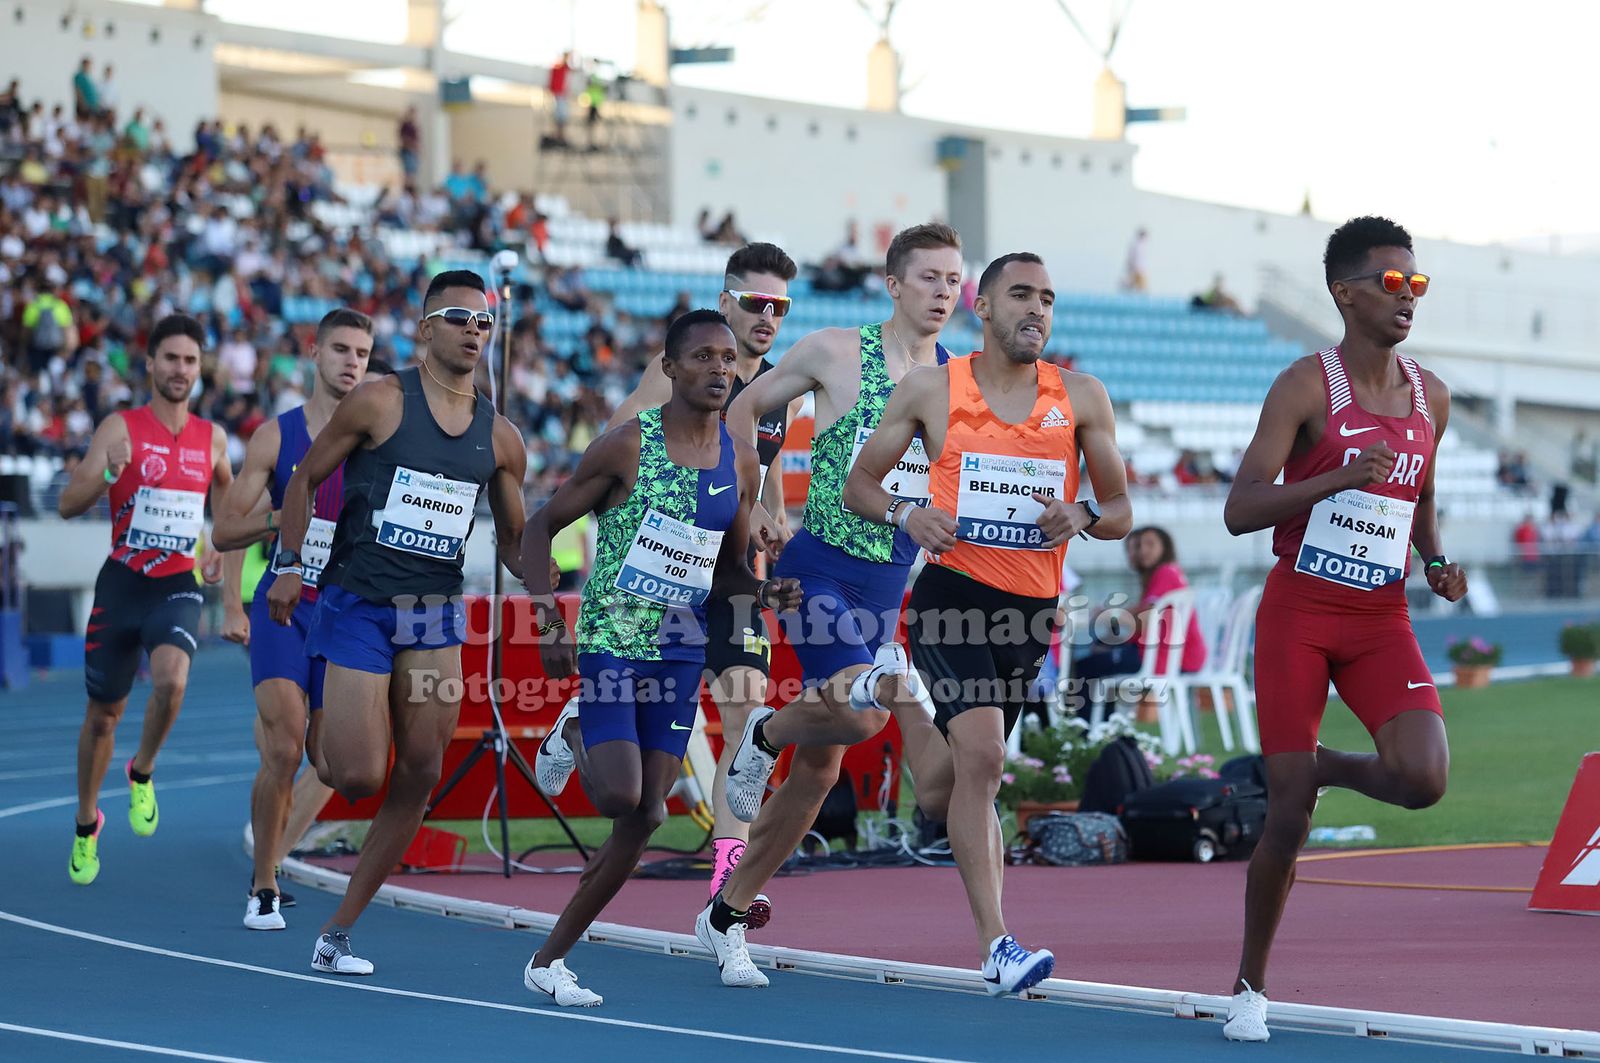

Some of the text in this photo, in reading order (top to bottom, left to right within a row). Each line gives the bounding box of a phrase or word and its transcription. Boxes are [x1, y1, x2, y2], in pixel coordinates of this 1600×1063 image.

[1041, 419, 1070, 428] adidas
[893, 461, 930, 475] OWSK
[991, 465, 1017, 473] HUELVA
[890, 482, 899, 493] 4
[970, 480, 1055, 498] BELBACHIR
[402, 493, 463, 515] GARRIDO
[1347, 498, 1372, 511] HUELVA
[144, 505, 195, 520] ESTEVEZ
[1007, 507, 1017, 519] 7
[424, 520, 433, 531] 9
[1329, 512, 1396, 540] HASSAN
[670, 529, 692, 541] HUELVA
[967, 523, 1043, 544] Joma
[636, 535, 715, 569] KIPNGETICH
[1349, 544, 1368, 558] 12
[310, 556, 324, 566] 11
[664, 564, 688, 579] 100
